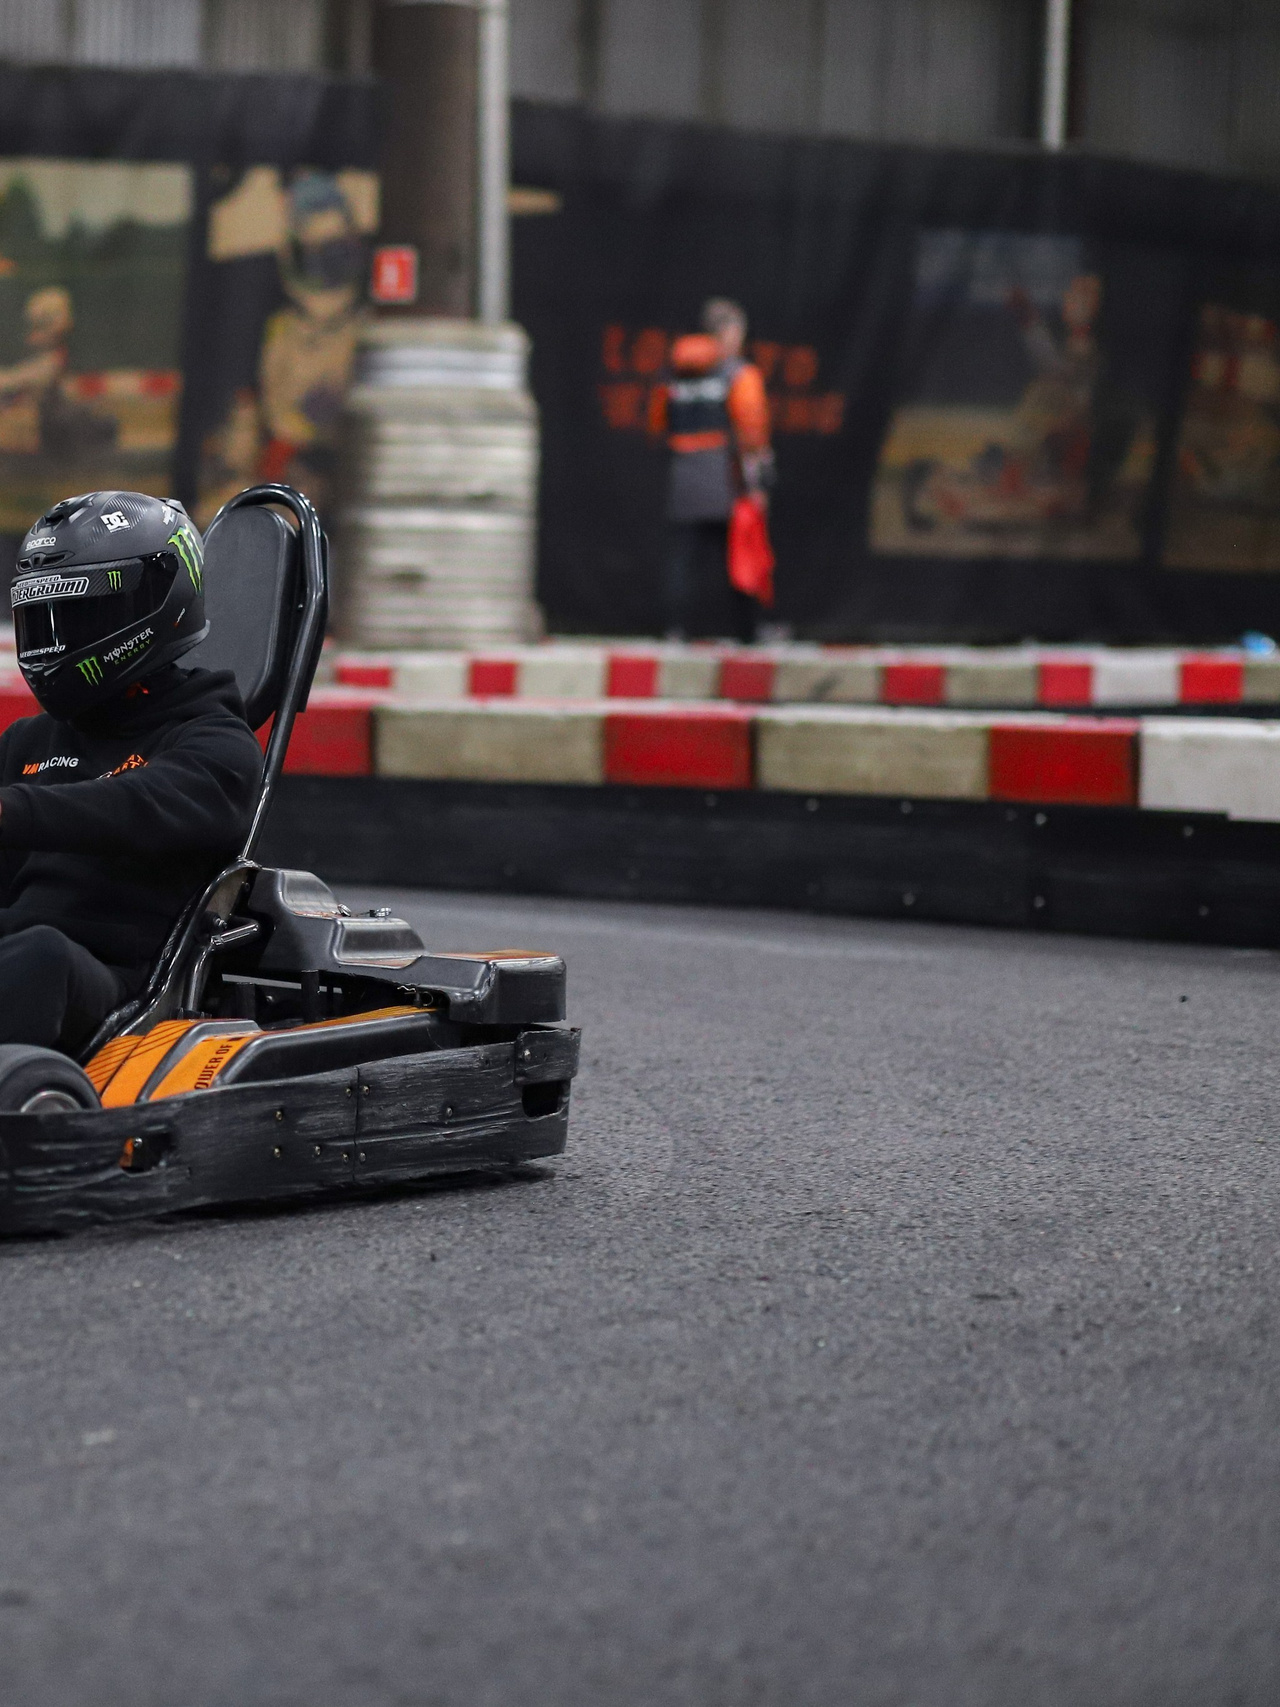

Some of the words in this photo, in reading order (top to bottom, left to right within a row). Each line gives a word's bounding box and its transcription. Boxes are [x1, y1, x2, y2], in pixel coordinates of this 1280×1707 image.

[25, 536, 57, 551] sparco
[103, 627, 154, 663] MONSTER
[194, 1057, 224, 1090] OWER
[215, 1044, 233, 1055] OF
